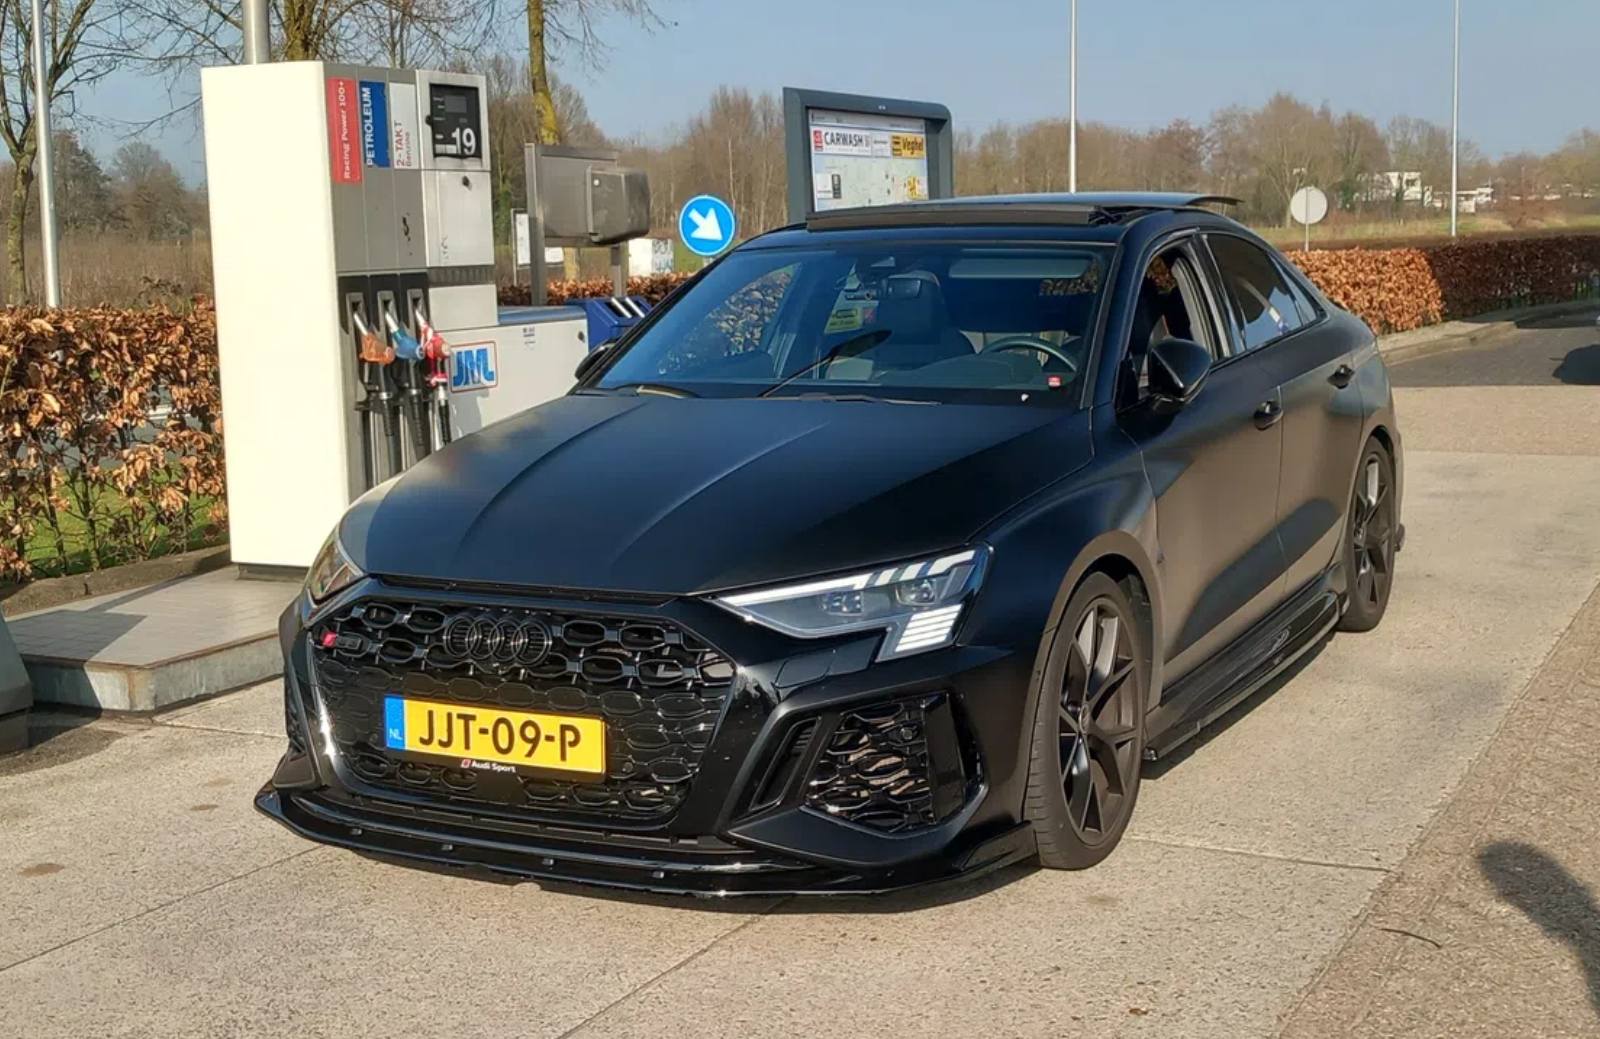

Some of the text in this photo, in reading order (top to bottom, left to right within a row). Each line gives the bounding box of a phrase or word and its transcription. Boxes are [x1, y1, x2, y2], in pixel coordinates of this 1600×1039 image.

[338, 81, 352, 179] Racing Power 100+
[362, 87, 375, 166] PETROLEUM
[394, 121, 405, 166] 2-TAKT
[451, 127, 476, 155] 19
[824, 130, 863, 147] CARWASH
[453, 348, 495, 387] JML
[389, 709, 582, 762] NL JJT-09-P
[471, 759, 517, 773] Audi Sport
